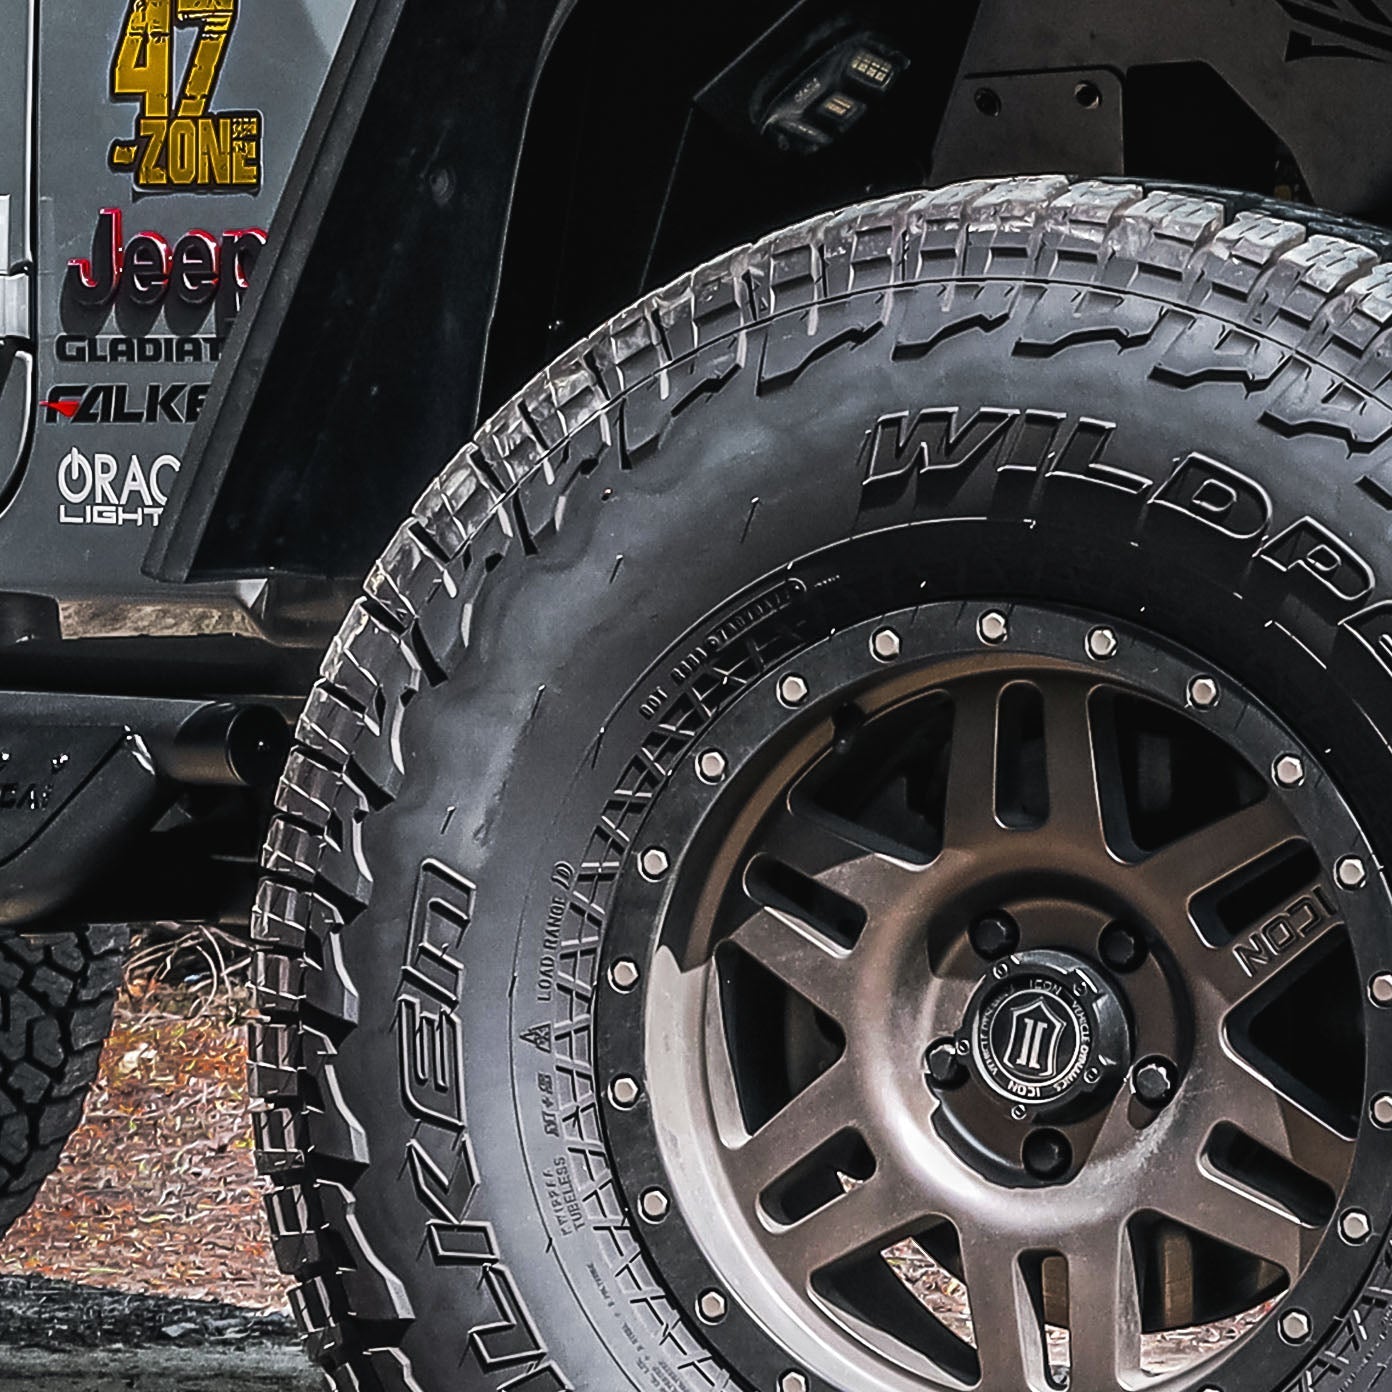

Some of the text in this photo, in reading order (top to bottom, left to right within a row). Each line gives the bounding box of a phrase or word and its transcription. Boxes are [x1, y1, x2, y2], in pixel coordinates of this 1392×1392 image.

[60, 208, 268, 330] Jeep
[1231, 884, 1338, 977] ICON
[1007, 1079, 1041, 1098] ICON
[553, 1156, 586, 1232] TUBELESS
